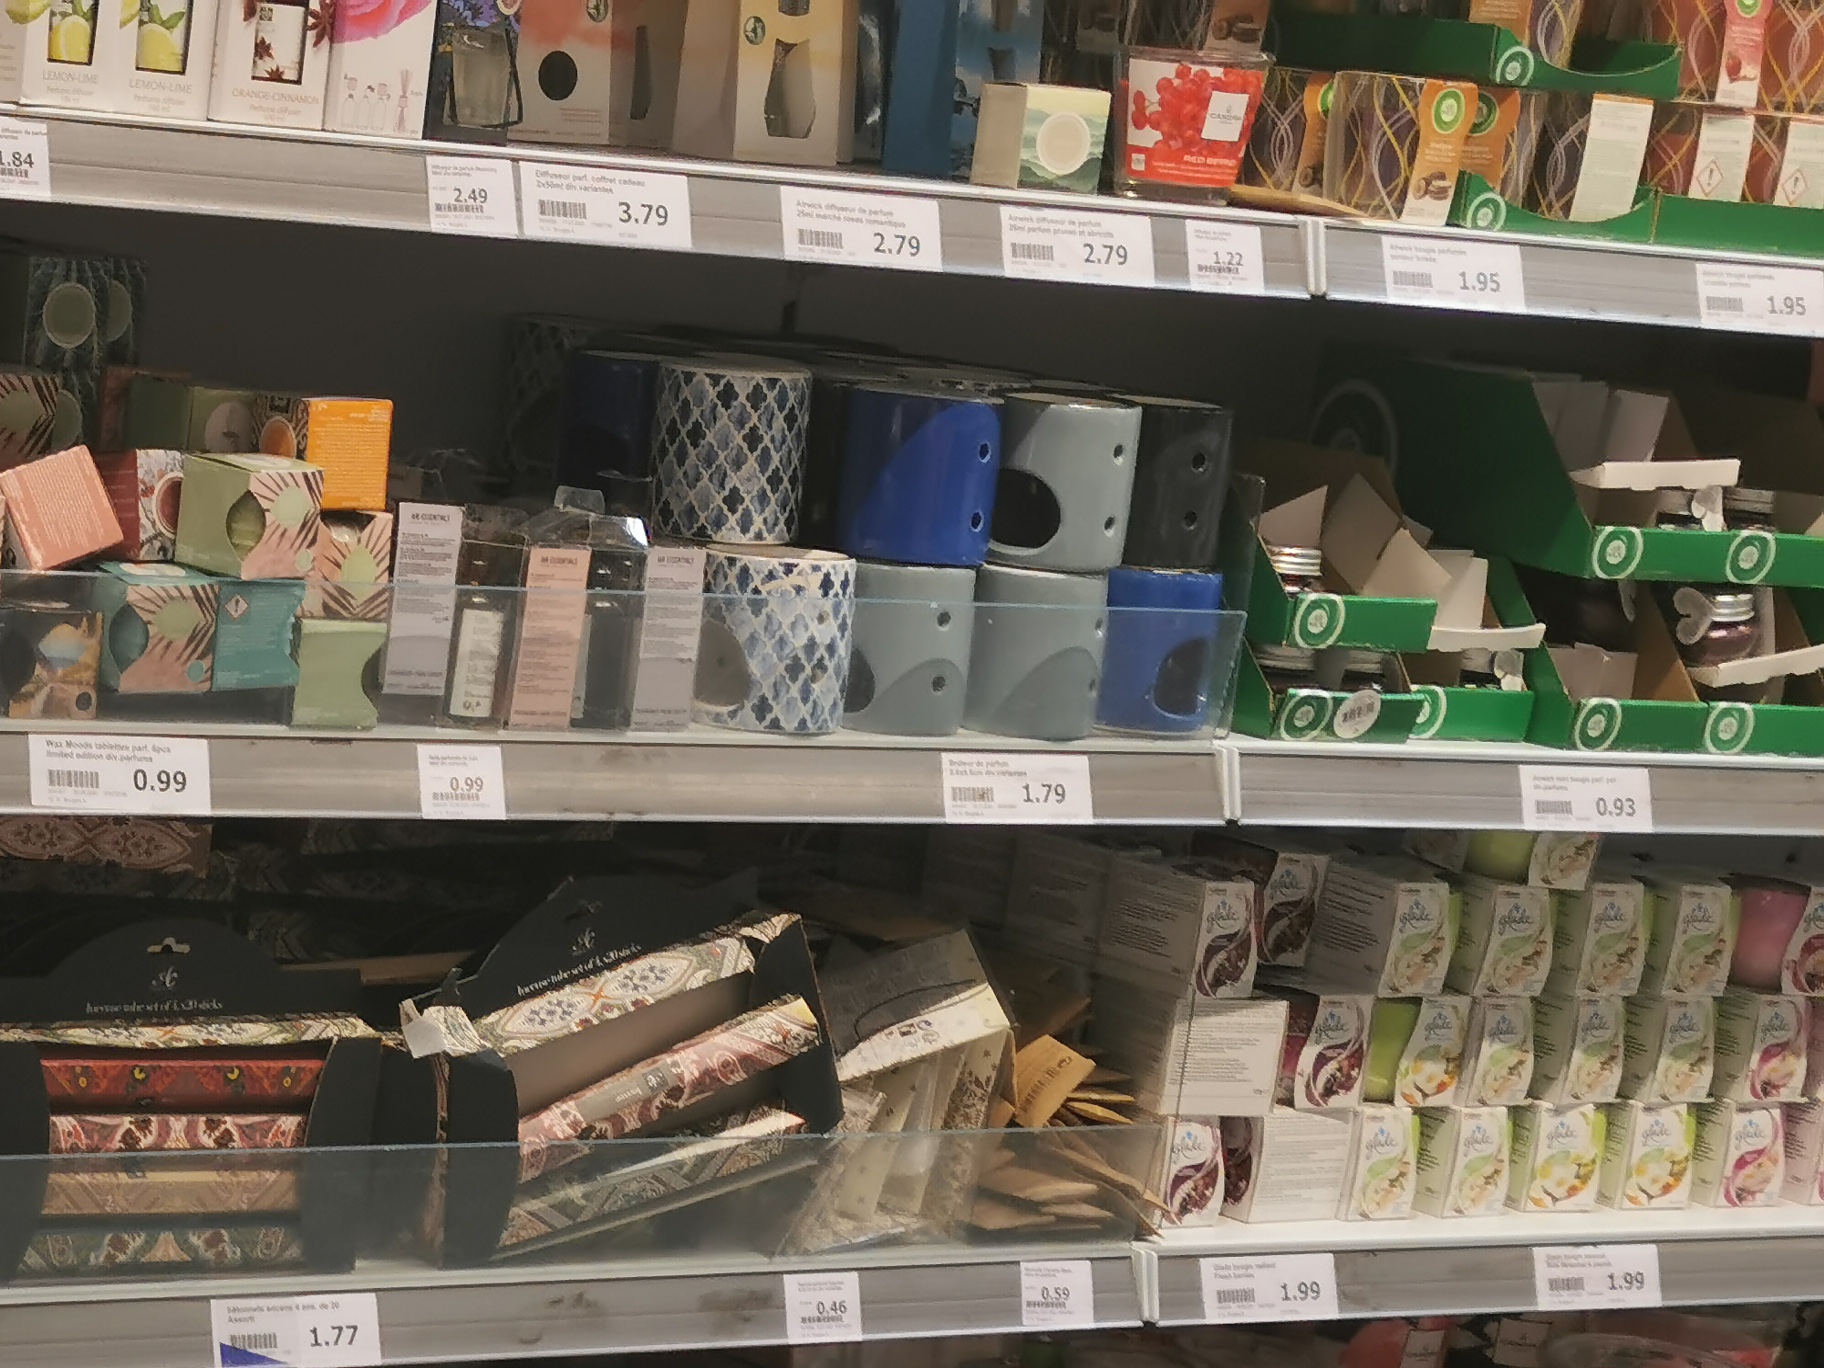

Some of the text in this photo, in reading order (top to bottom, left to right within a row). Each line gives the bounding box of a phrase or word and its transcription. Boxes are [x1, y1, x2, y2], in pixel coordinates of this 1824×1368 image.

[42, 70, 99, 85] LEMON-LIME
[128, 78, 193, 95] LEMON-LIME
[232, 88, 319, 105] ORANGE-CINNAMON
[452, 187, 488, 204] 2.49
[618, 201, 668, 226] 3.79
[873, 232, 920, 257] 2.79
[1082, 243, 1128, 266] 2.79
[1212, 251, 1244, 266] 1.22
[1458, 270, 1501, 293] 1.95
[1767, 295, 1806, 316] 1.95
[46, 739, 63, 749] Wax
[133, 769, 187, 793] 0.99
[449, 776, 484, 792] 0.99
[1022, 783, 1066, 805] 1.79
[1595, 797, 1636, 817] 0.93
[1608, 1271, 1645, 1290] 1.99
[1280, 1281, 1321, 1301] 1.99
[816, 1300, 847, 1315] 0.46
[309, 1324, 358, 1347] 1.77
